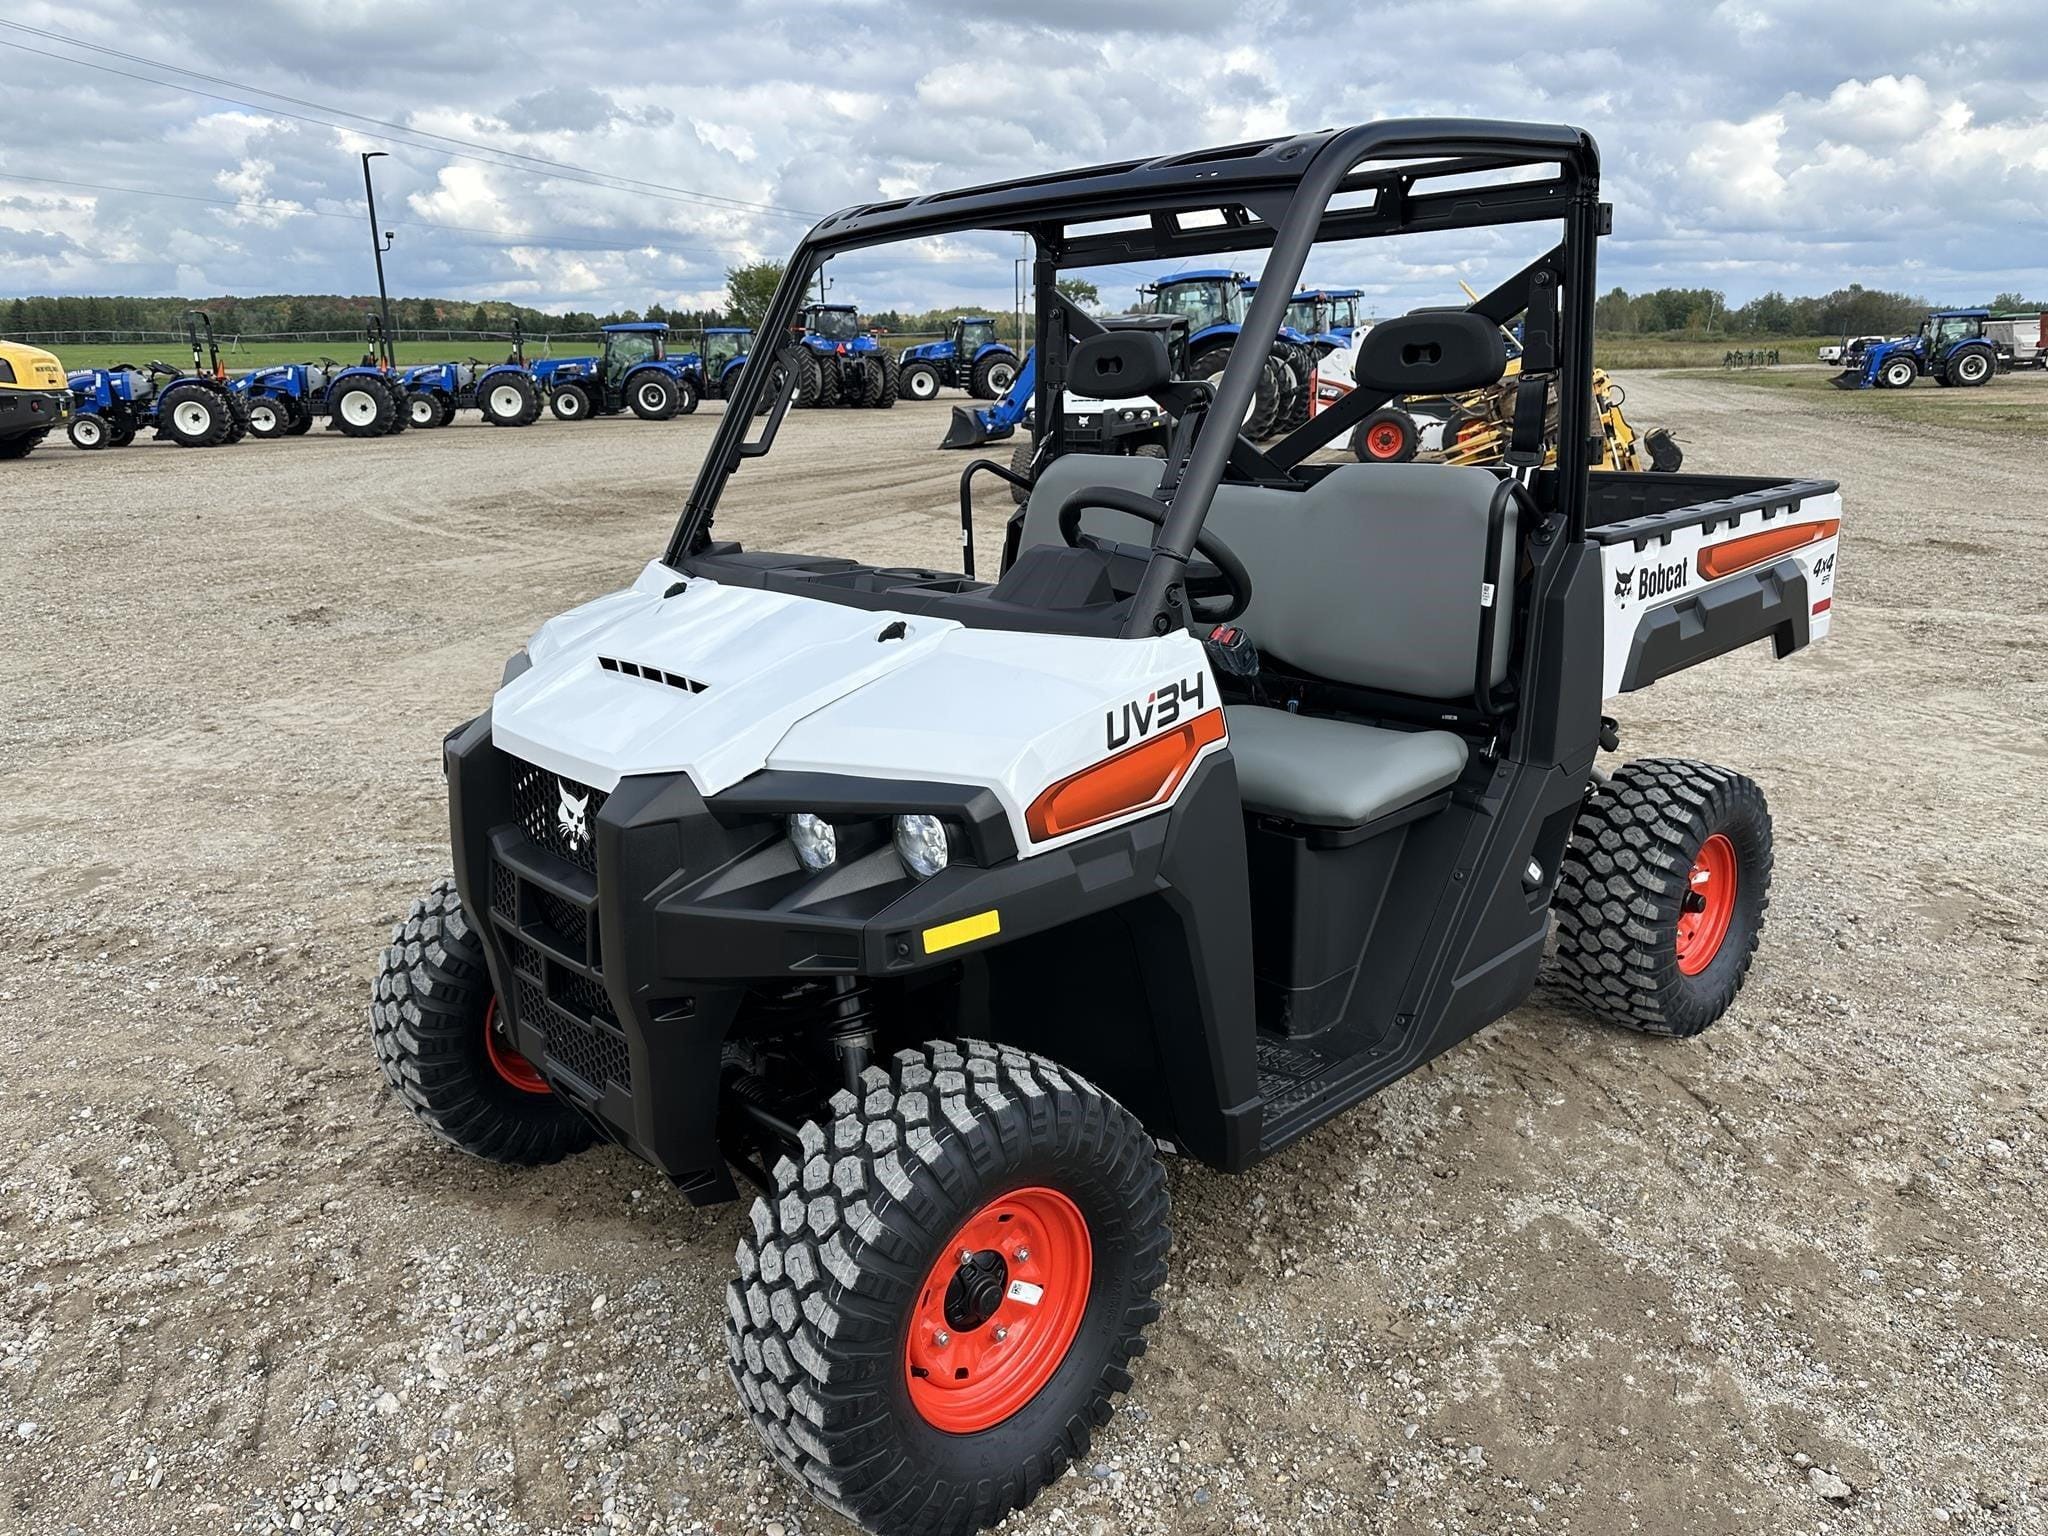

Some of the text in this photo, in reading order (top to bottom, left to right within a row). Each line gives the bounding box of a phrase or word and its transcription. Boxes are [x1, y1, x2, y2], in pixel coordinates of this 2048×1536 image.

[1639, 557, 1688, 601] Bobcat
[1813, 553, 1835, 578] 4x4
[1106, 671, 1204, 751] UV34
